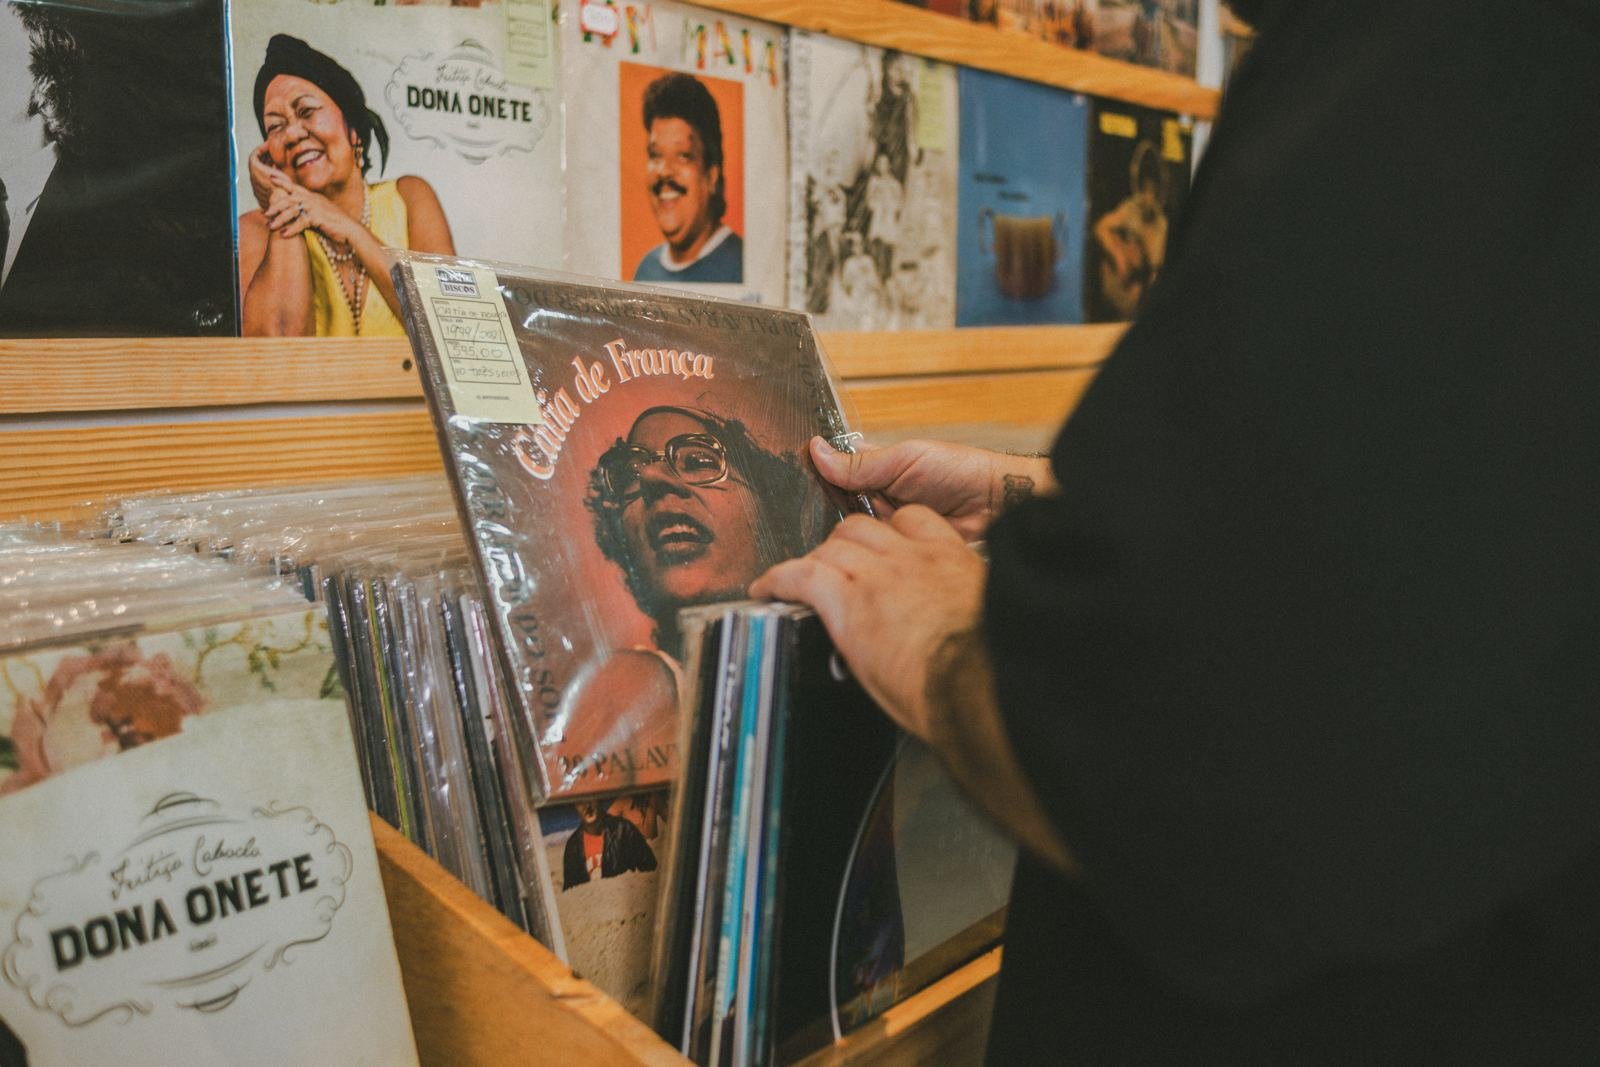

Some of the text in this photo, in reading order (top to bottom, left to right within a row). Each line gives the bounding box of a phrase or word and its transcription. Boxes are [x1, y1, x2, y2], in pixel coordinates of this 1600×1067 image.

[406, 85, 532, 123] DONA ONETE
[571, 355, 610, 404] de
[603, 338, 715, 385] França
[49, 853, 319, 973] DONA ONETE
